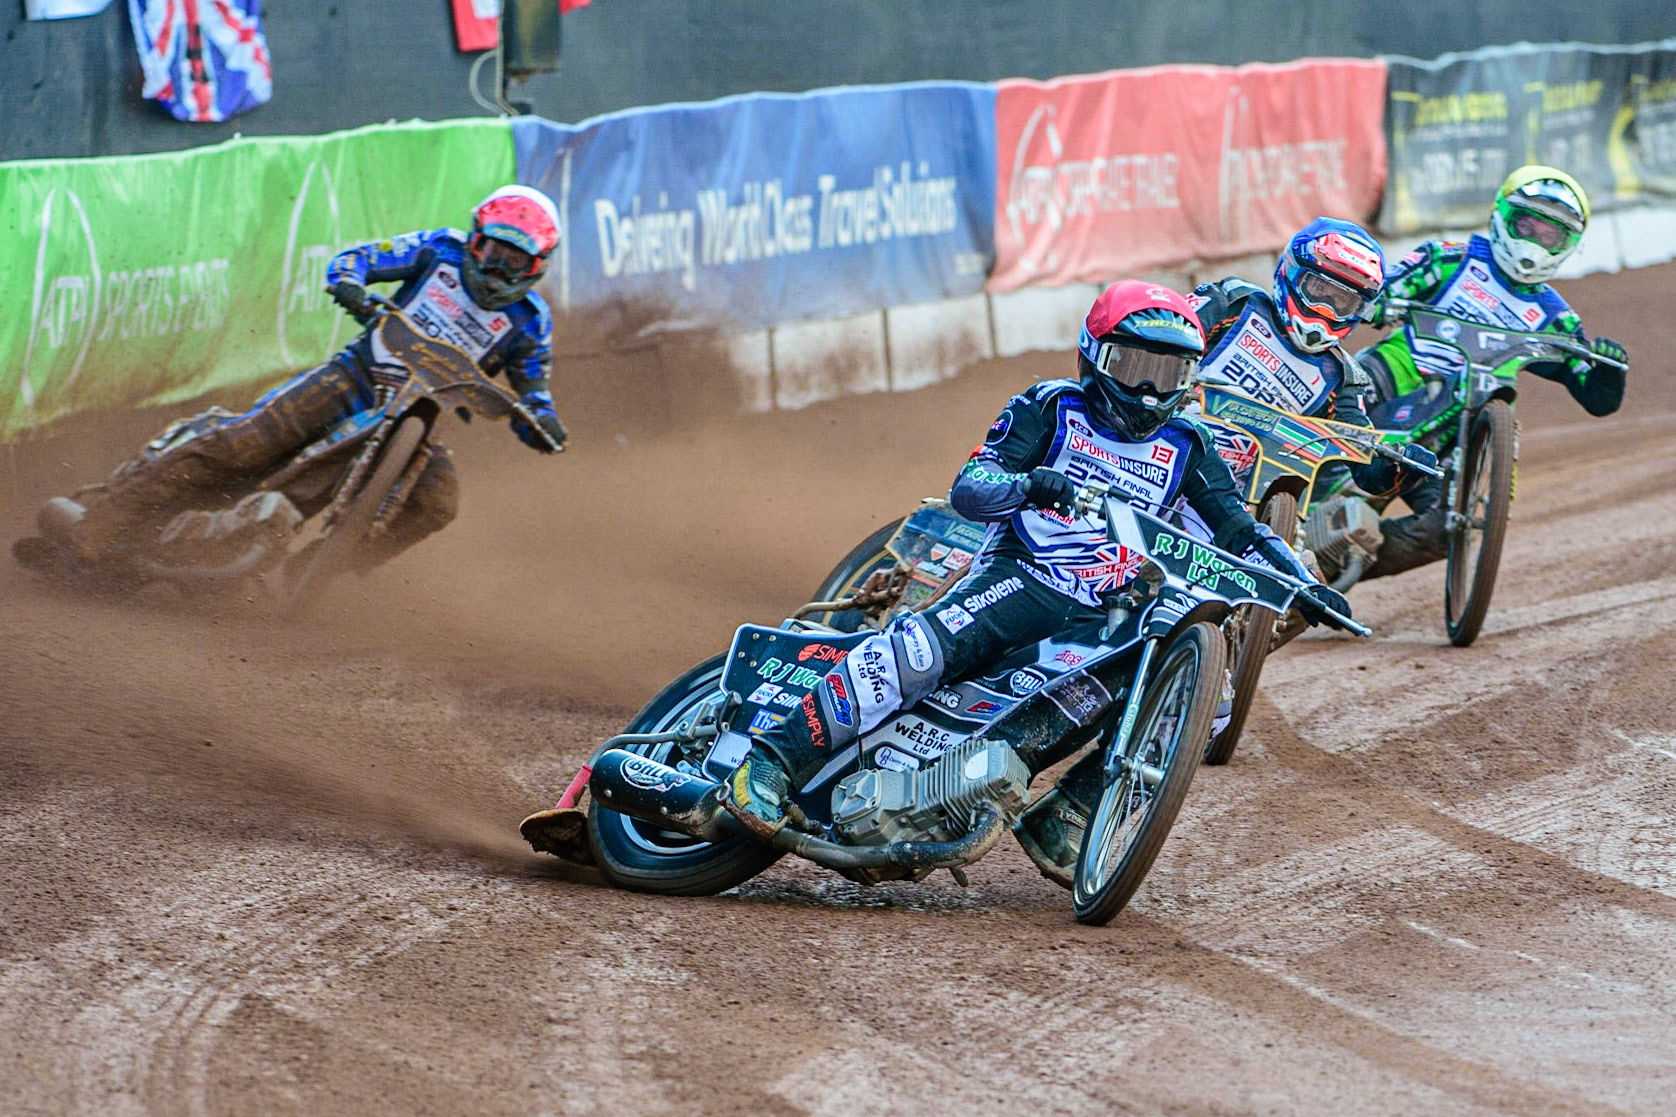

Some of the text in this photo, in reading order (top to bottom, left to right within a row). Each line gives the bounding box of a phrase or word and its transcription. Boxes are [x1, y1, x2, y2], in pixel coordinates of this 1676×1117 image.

[1240, 334, 1313, 406] SPORTS INSURE
[1072, 435, 1167, 486] SPORTS INSURE
[1151, 444, 1174, 465] 13
[1070, 455, 1121, 484] BRITISH
[1122, 479, 1153, 500] FINAL
[1071, 565, 1112, 578] RITISH
[1186, 562, 1220, 591] Ltd
[1193, 544, 1257, 593] Warren
[863, 642, 884, 704] WELDING
[803, 700, 826, 747] SIMPLY
[895, 721, 953, 752] WELDING
[912, 743, 931, 755] Ltd
